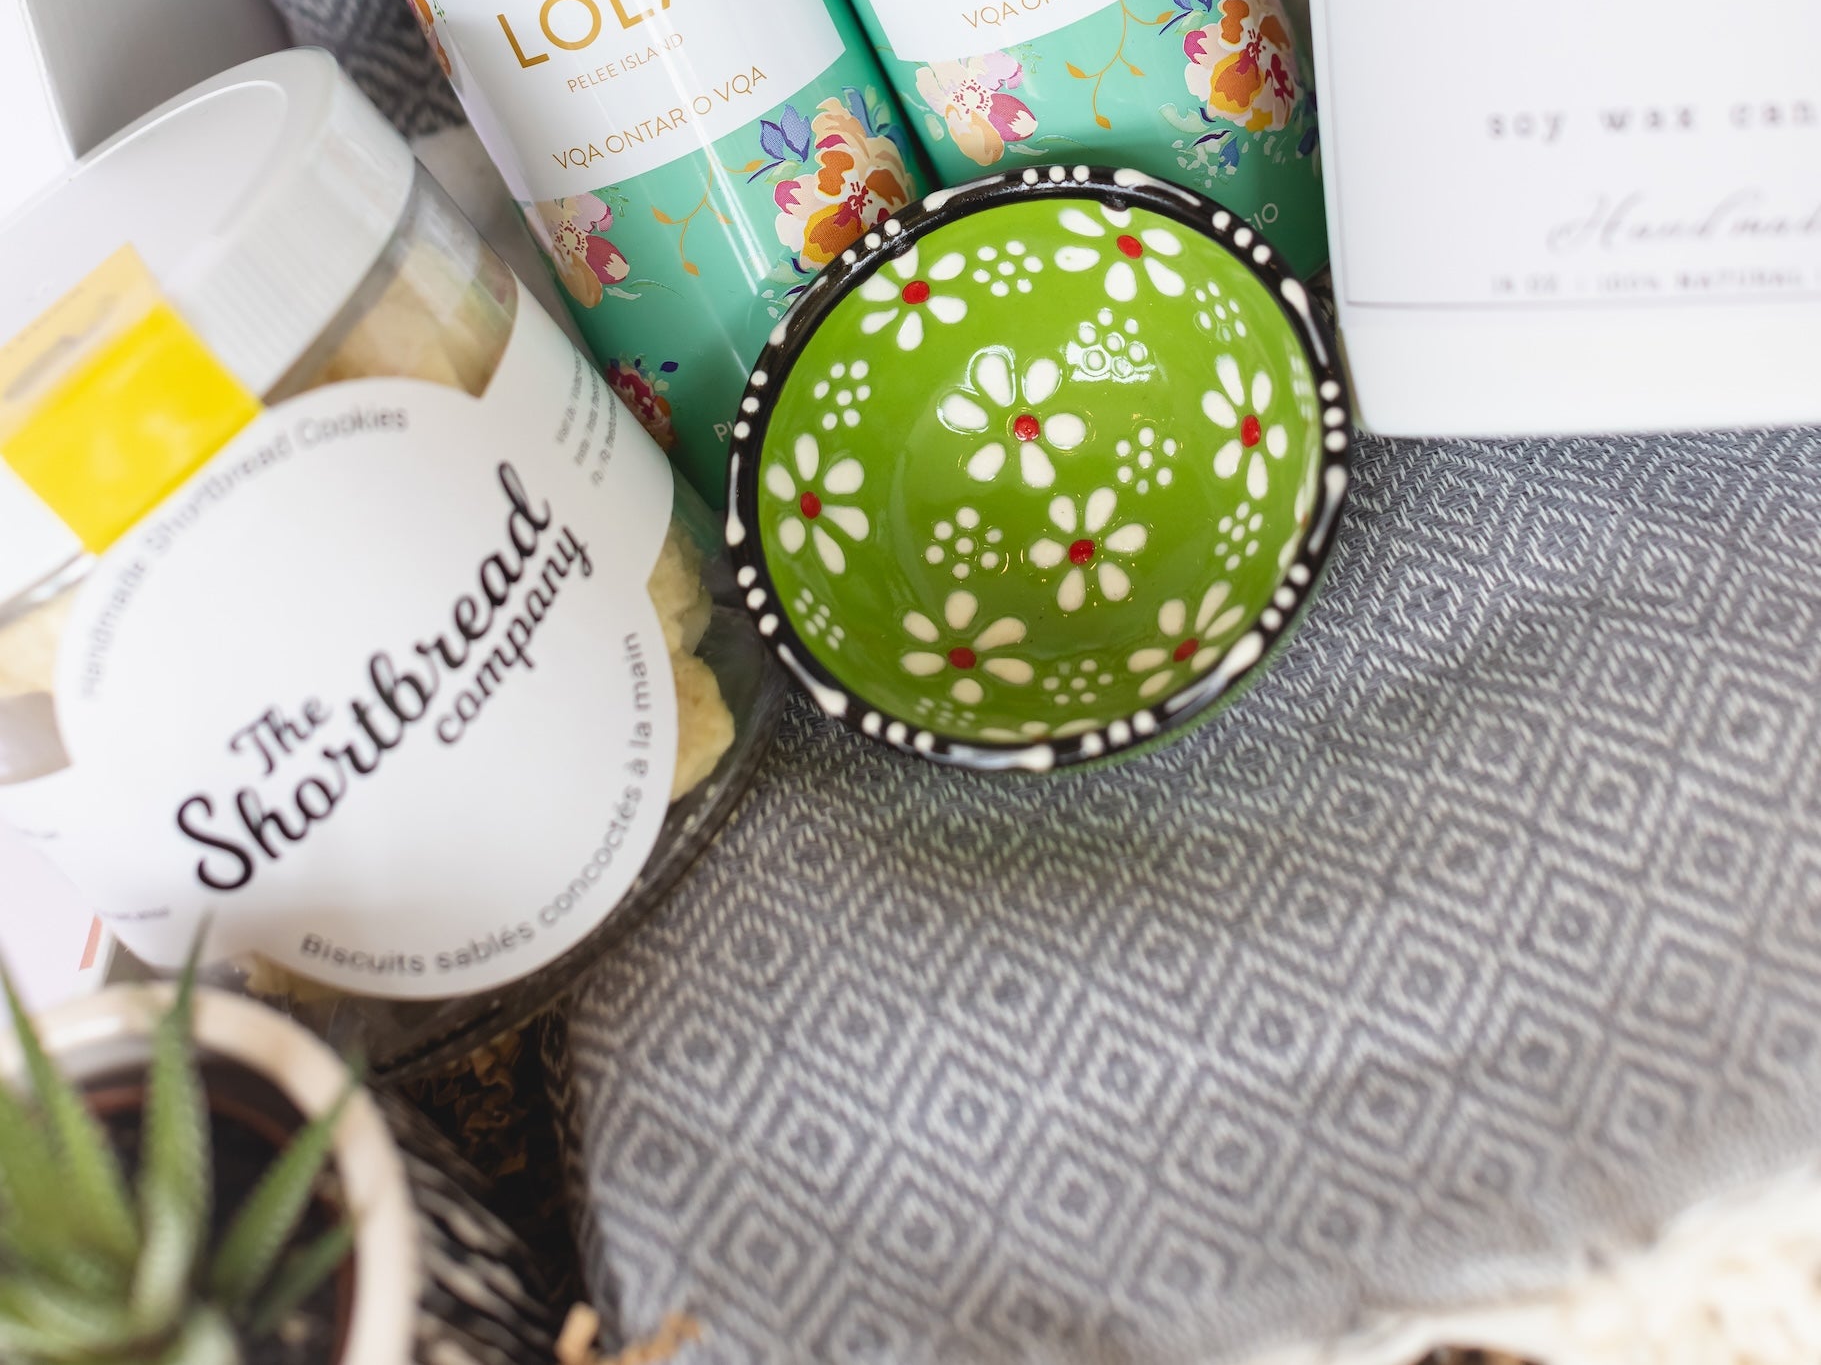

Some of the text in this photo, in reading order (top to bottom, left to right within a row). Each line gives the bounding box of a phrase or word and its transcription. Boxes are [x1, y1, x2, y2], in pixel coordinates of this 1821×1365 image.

[962, 0, 1020, 29] VQA
[552, 65, 767, 171] VQA ONTARO VQA
[566, 63, 619, 94] PELEE
[144, 432, 293, 554] Shortbread
[297, 406, 410, 448] Cookies
[176, 461, 551, 891] Shortbread
[436, 525, 593, 745] company
[229, 696, 331, 776] The
[300, 632, 652, 976] Biscuits sablés concoctés à la main
